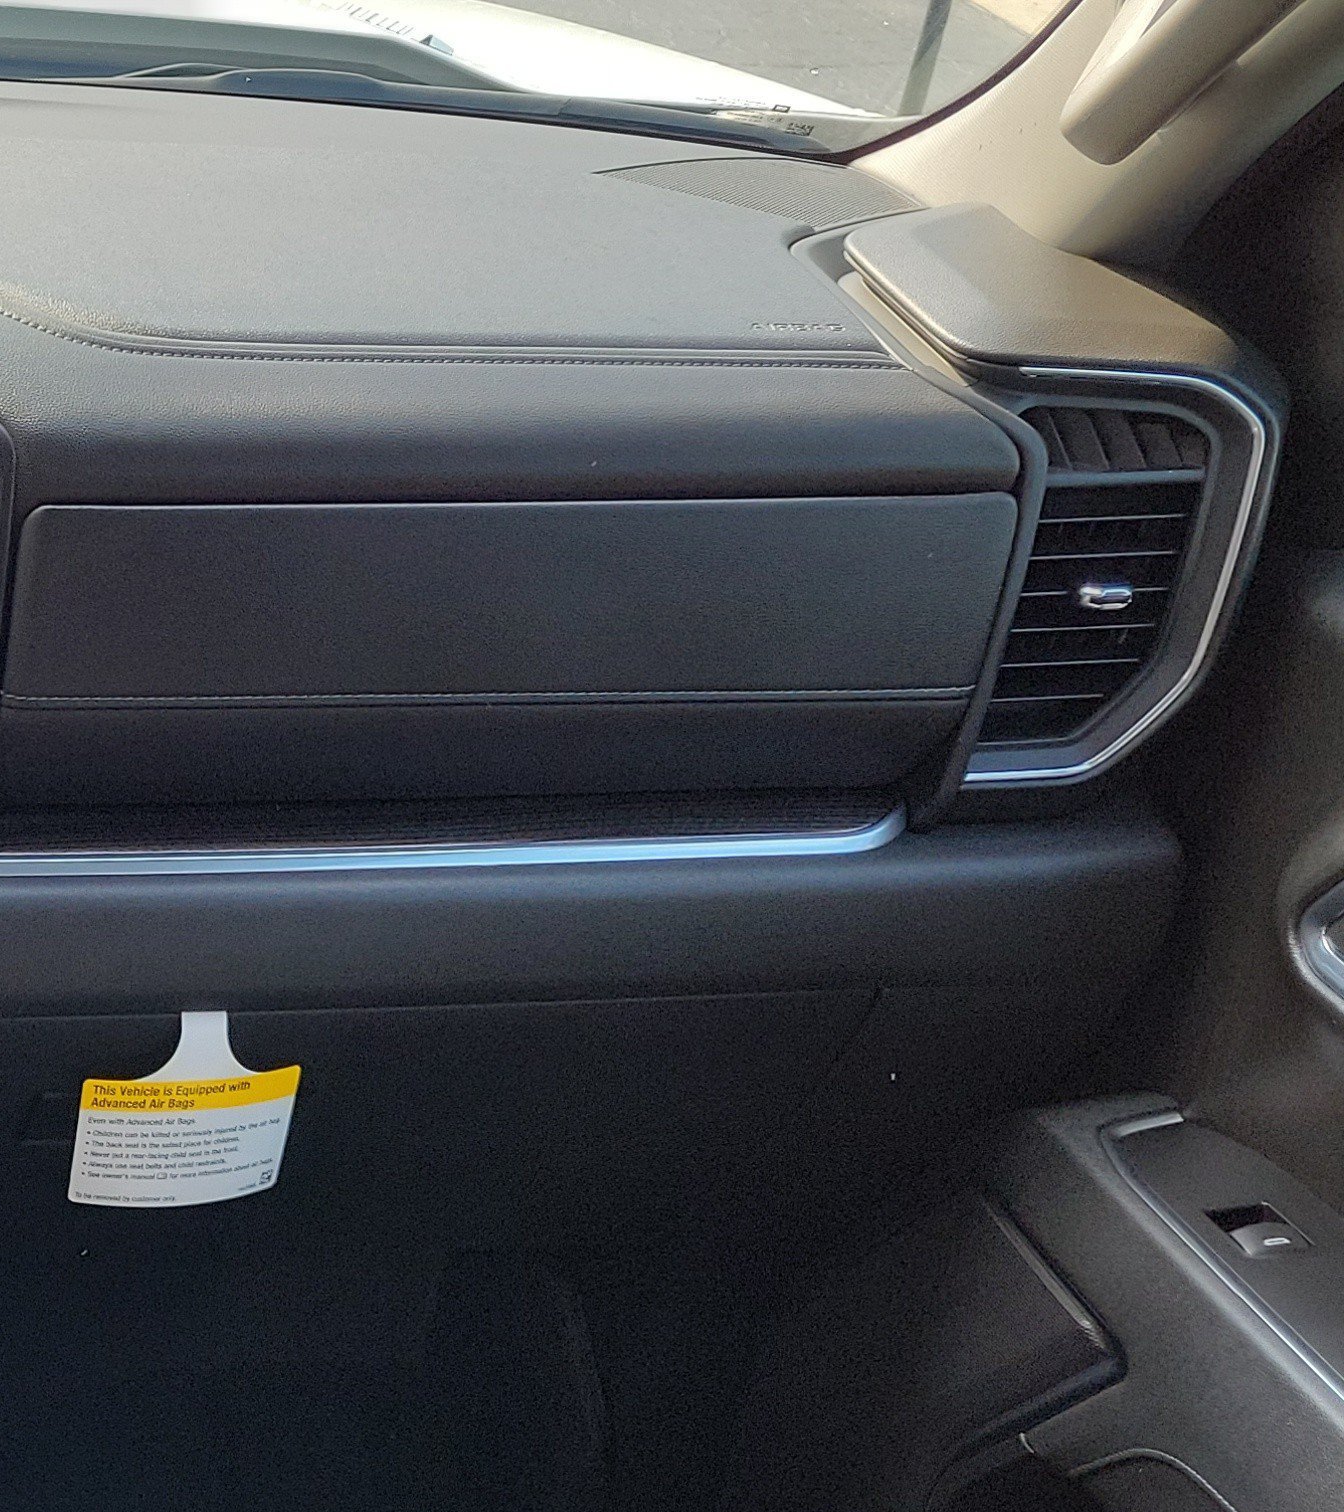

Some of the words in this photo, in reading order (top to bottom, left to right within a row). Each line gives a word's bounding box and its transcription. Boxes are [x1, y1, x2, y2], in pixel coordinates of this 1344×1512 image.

[93, 1085, 117, 1096] This
[120, 1086, 160, 1096] Vehicle
[163, 1086, 173, 1096] is
[176, 1083, 226, 1097] Equipped
[228, 1081, 251, 1092] with
[91, 1098, 146, 1109] Advanced
[149, 1099, 166, 1108] Air
[168, 1099, 195, 1110] Bags
